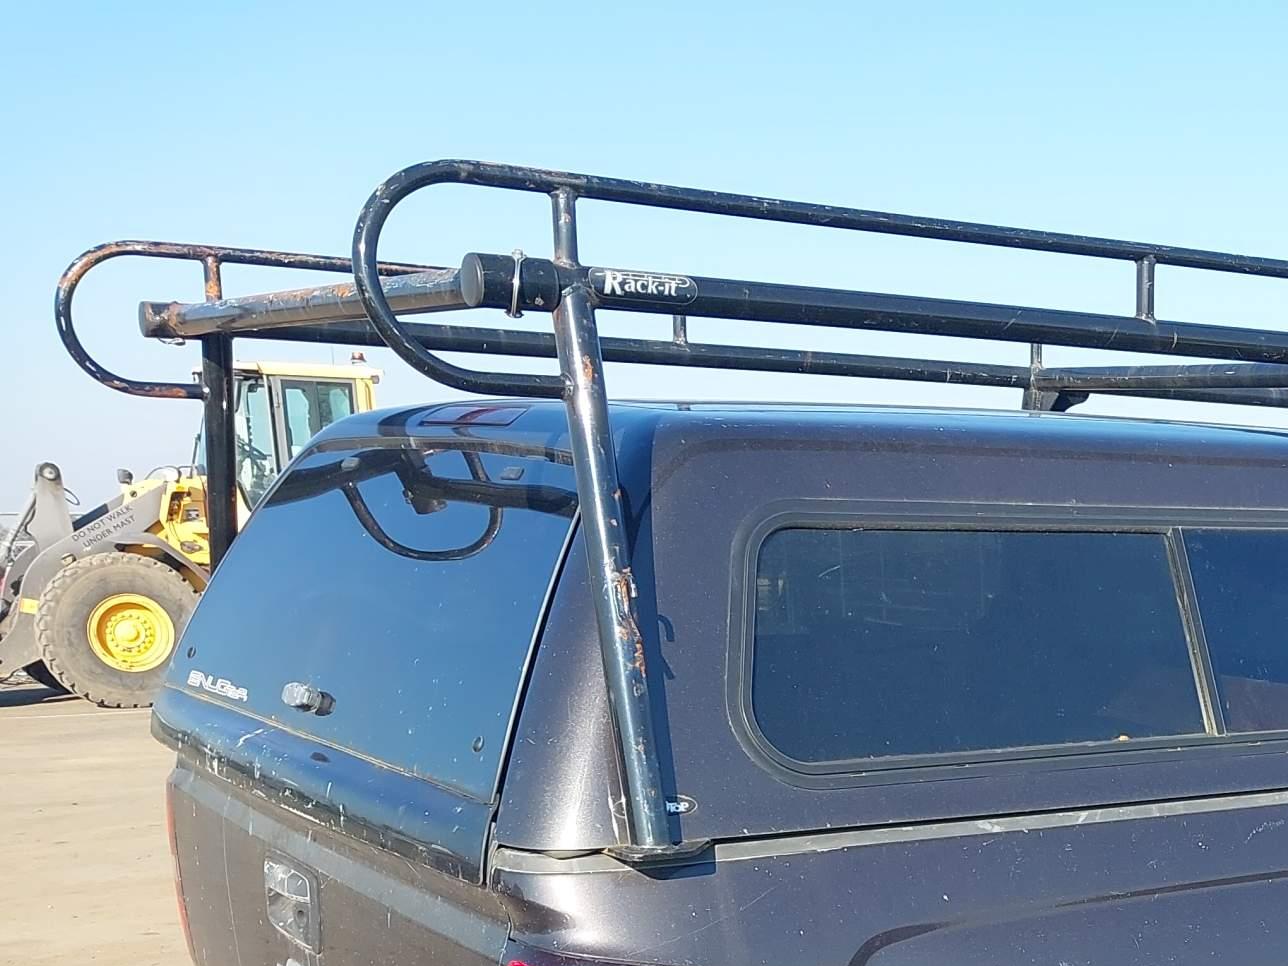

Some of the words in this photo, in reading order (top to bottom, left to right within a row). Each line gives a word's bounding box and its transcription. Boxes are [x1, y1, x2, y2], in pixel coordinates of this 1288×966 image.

[71, 529, 87, 542] DO
[88, 519, 107, 534] NOT
[106, 504, 134, 526] WALK
[82, 528, 113, 549] UNDER
[113, 514, 136, 532] MAST
